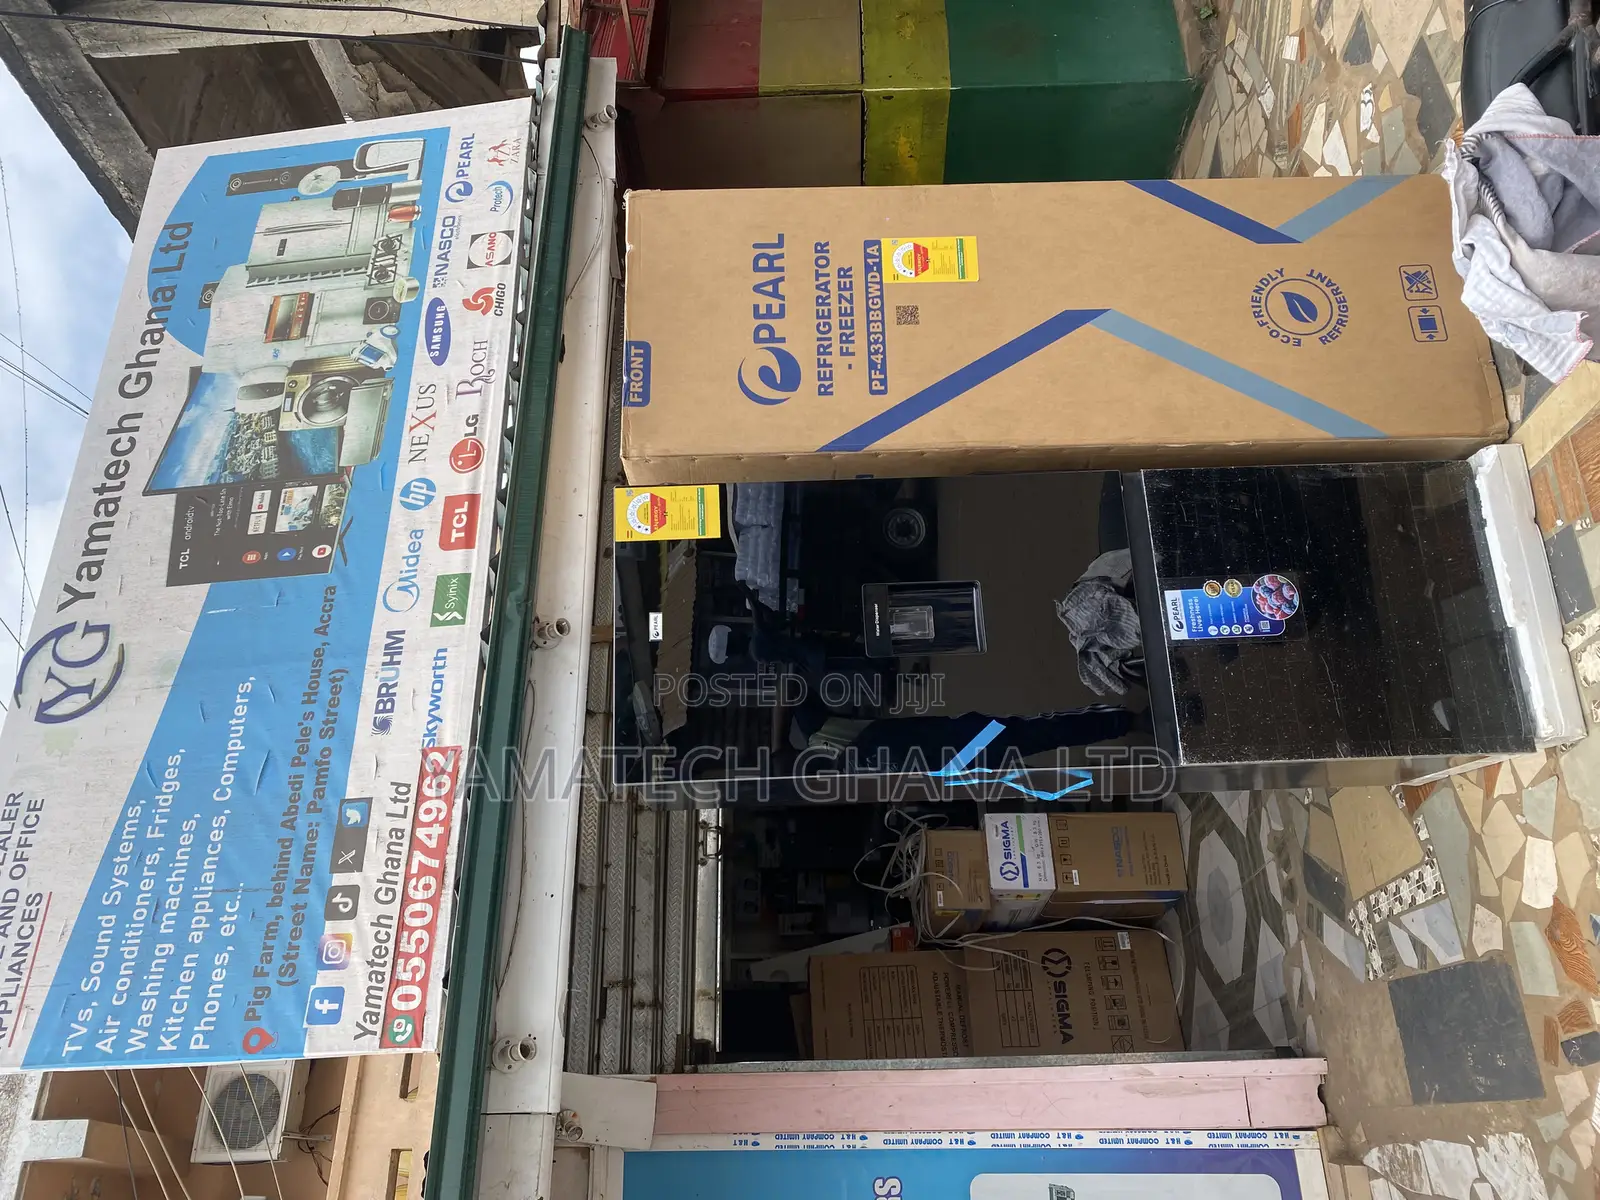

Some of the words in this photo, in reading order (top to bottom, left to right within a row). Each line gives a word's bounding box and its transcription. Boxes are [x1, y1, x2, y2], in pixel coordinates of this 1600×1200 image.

[455, 132, 475, 179] PEARL
[510, 137, 522, 164] ZARA
[489, 186, 505, 213] Protech
[434, 215, 456, 276] NASCO
[484, 232, 497, 267] ASANO
[493, 282, 506, 317] CHIGO
[752, 233, 787, 345] PEARL
[814, 241, 834, 397] REFRIGERATOR
[837, 266, 856, 357] FREEZER
[866, 244, 886, 391] PF-433BBGWD-1A
[1251, 267, 1302, 347] ECO-FRIENDLY
[1306, 268, 1349, 345] REFRIGERANT
[429, 305, 447, 357] SAMSUNG
[629, 345, 646, 403] FRONT
[56, 412, 144, 613] Yamatech
[118, 284, 178, 399] Ghana
[151, 222, 194, 274] Ltd
[407, 383, 437, 465] NEXUS
[464, 413, 479, 438] LG
[399, 481, 436, 507] hp
[450, 500, 469, 543] TCL
[178, 548, 190, 569] TCL
[395, 529, 424, 599] Midea
[314, 585, 337, 636] Accra
[444, 576, 460, 609] Syinix
[1170, 598, 1179, 620] PEARL
[301, 641, 330, 705] House,
[318, 668, 349, 740] Street)
[374, 629, 406, 715] BRÜHM
[290, 711, 315, 767] Pele's
[280, 774, 304, 831] Abedi
[306, 746, 332, 814] Pamfo
[386, 781, 412, 819] Ltd
[9, 798, 44, 880] OFFICE
[157, 954, 199, 1051] Kitchen
[186, 809, 231, 944] appliances,
[213, 676, 256, 802] Computers,
[292, 822, 320, 895] Name:
[374, 827, 406, 905] Ghana
[1000, 820, 1013, 860] SIGMA
[95, 1015, 121, 1054] Air
[111, 846, 165, 1005] conditioners,
[147, 748, 186, 839] Fridges,
[266, 837, 294, 908] behind
[391, 750, 455, 1011] 0550674962
[61, 1001, 98, 1057] TVs,
[80, 915, 117, 992] Sound
[102, 800, 147, 905] Systems,
[125, 943, 175, 1054] Washing
[158, 812, 201, 933] machines,
[252, 914, 284, 977] Farm,
[276, 902, 308, 987] (Street
[190, 945, 235, 1051] Phones,
[244, 986, 271, 1022] Pig
[354, 914, 393, 1041] Yamatech
[1051, 980, 1075, 1045] SIGMA
[990, 1132, 1016, 1140] LIMITED
[1206, 1132, 1232, 1140] LIMITED
[1234, 1132, 1268, 1140] COMPANY
